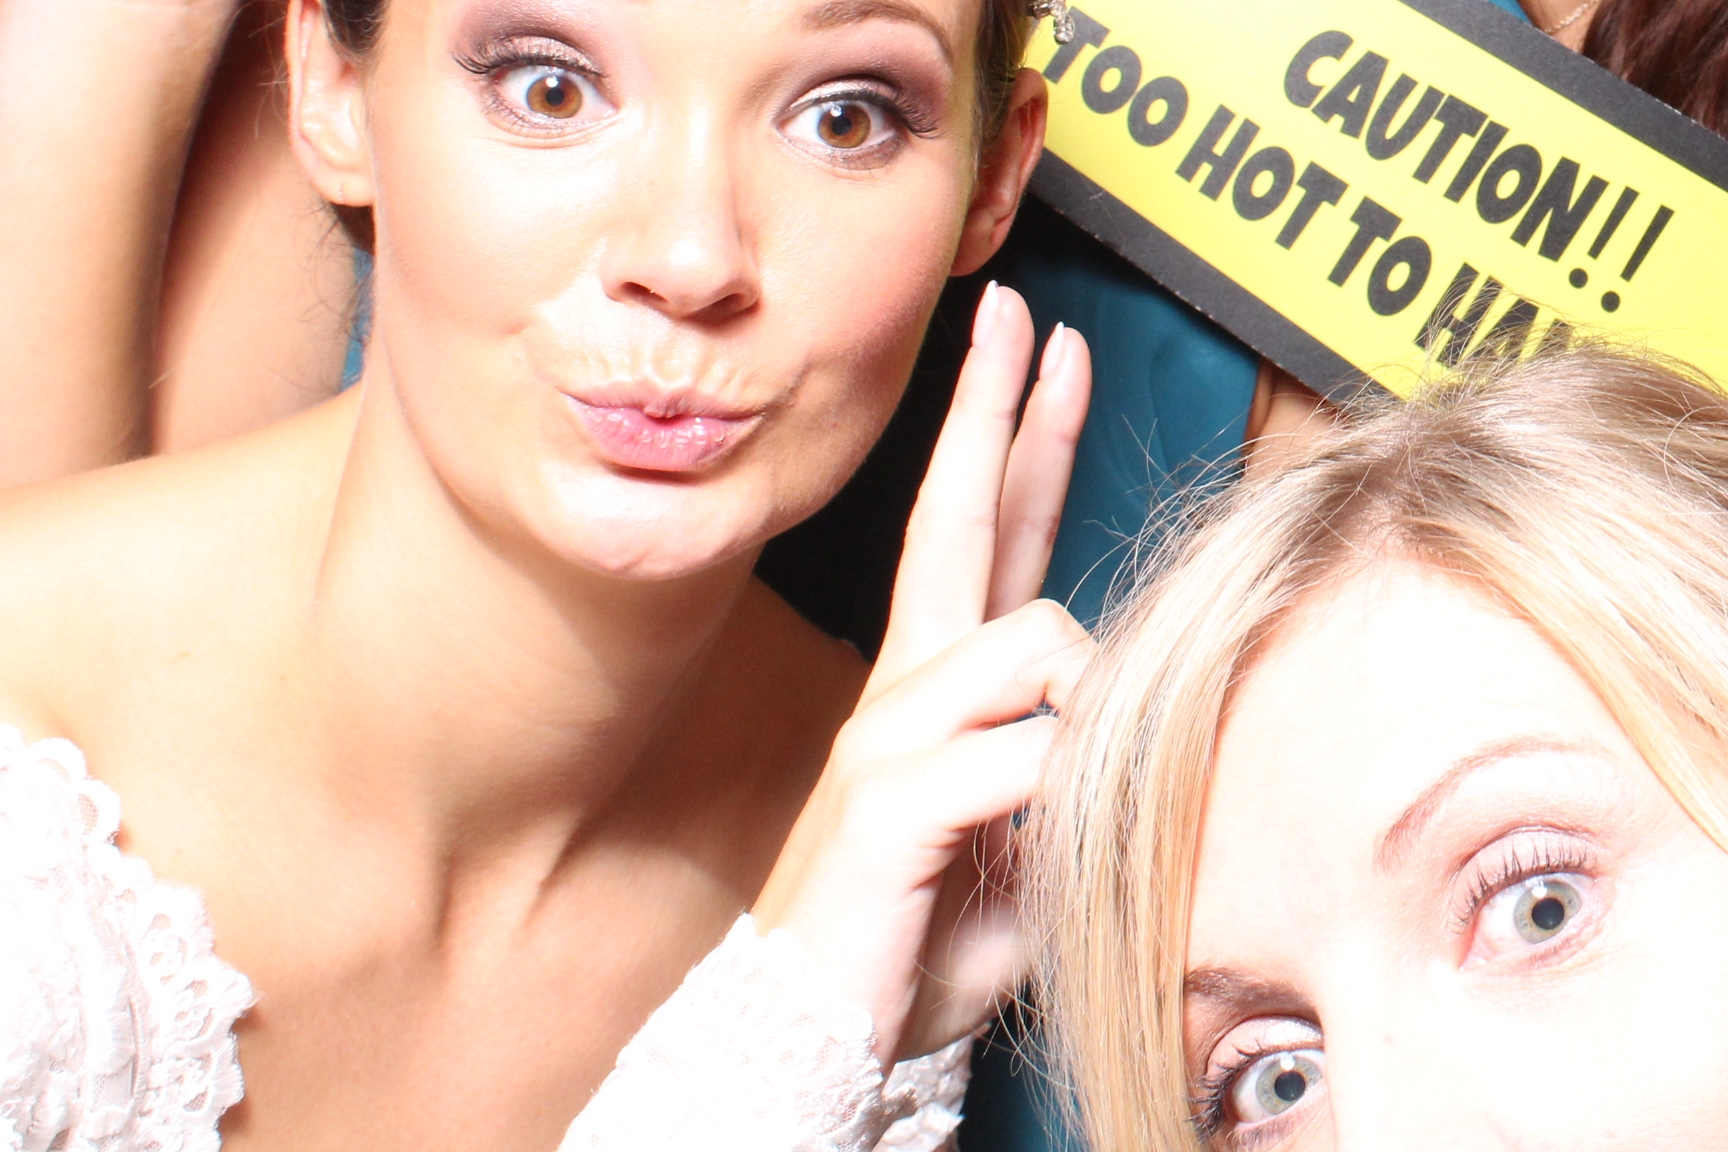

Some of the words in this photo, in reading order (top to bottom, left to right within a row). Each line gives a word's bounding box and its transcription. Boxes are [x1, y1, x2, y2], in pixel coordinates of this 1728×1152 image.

[1042, 5, 1190, 148] TOO
[1174, 104, 1350, 251] HOT
[1327, 195, 1432, 317] TO
[1283, 29, 1676, 314] CAUTION!!
